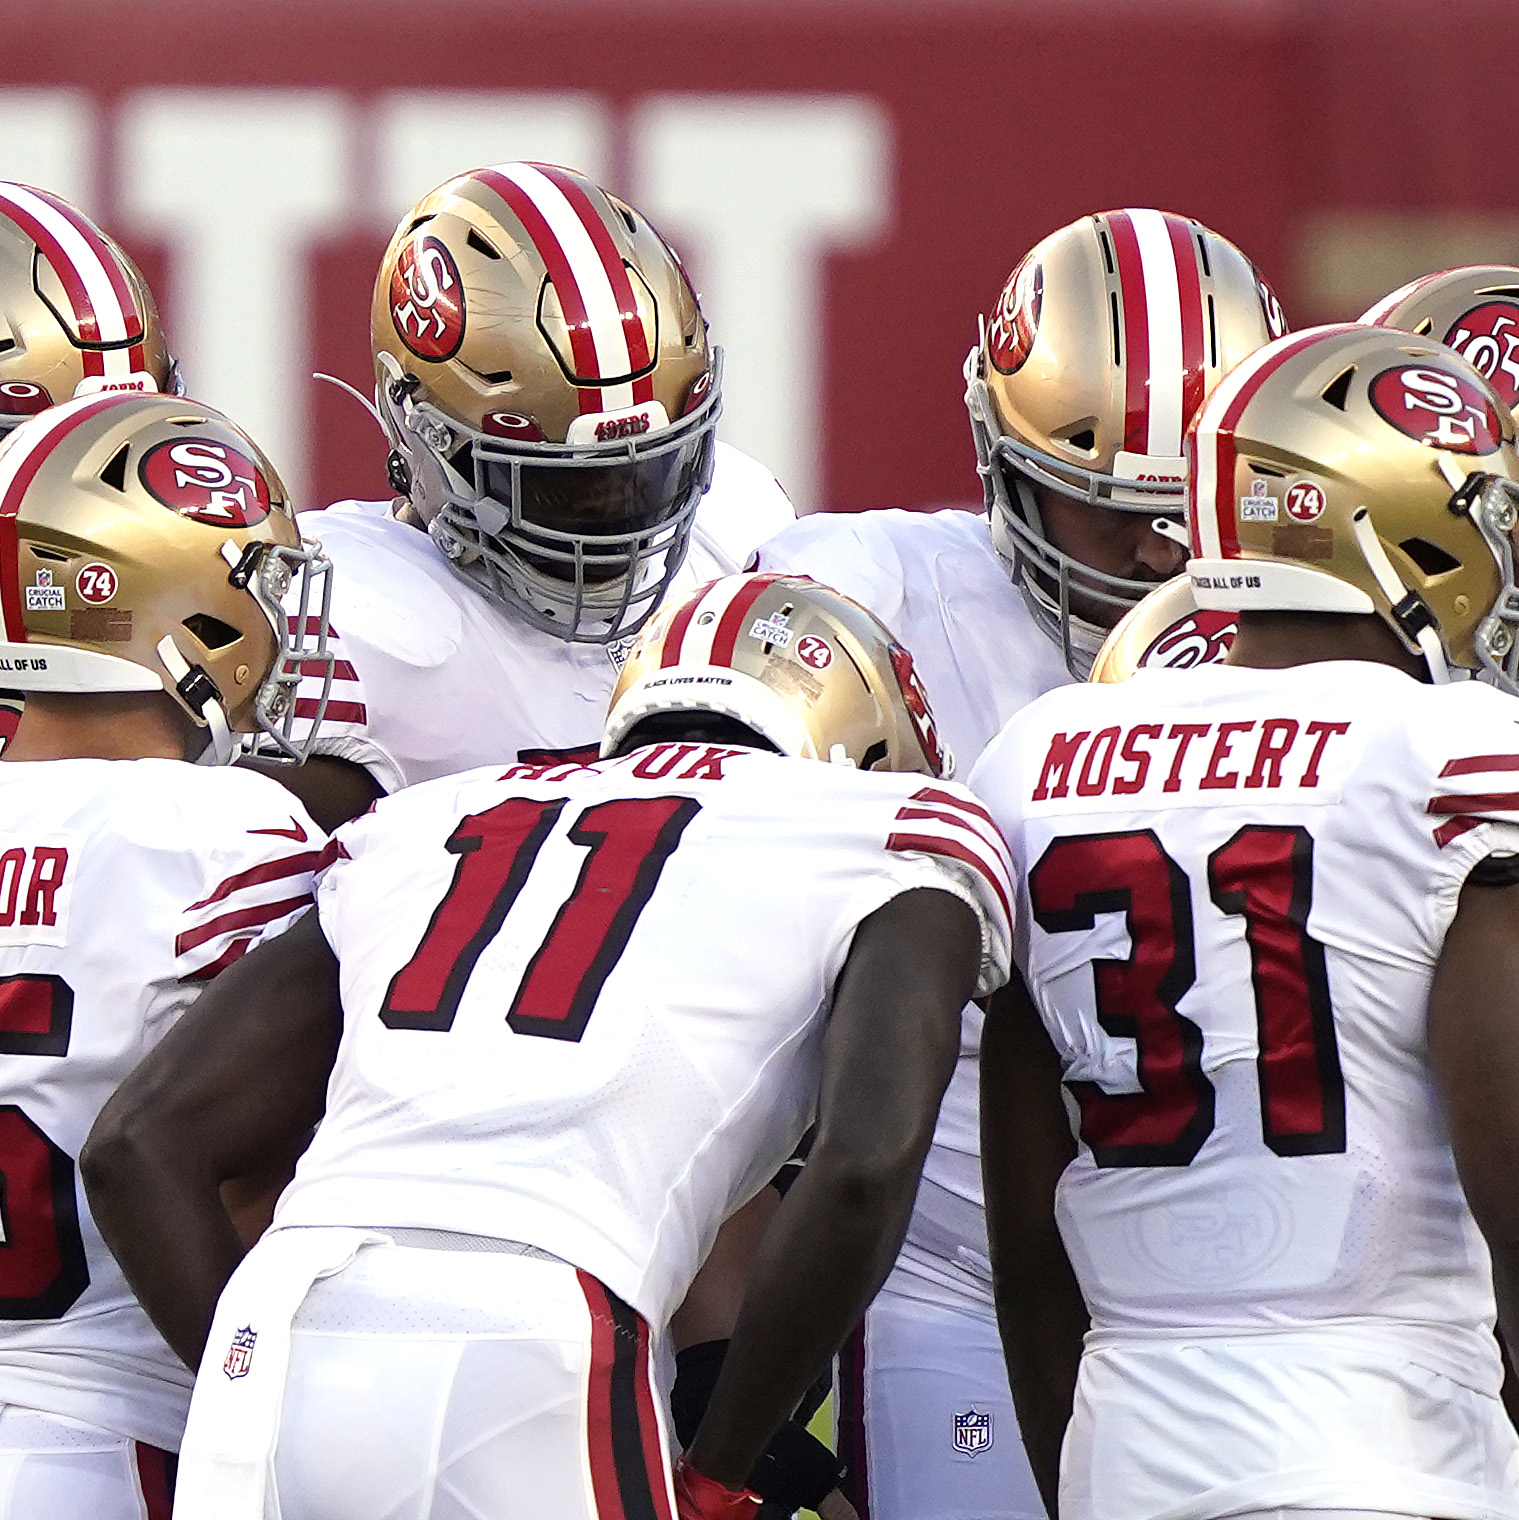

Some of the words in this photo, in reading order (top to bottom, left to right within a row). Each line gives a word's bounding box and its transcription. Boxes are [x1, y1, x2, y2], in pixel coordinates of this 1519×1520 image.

[1291, 488, 1320, 515] 74
[28, 588, 62, 596] CRUCIAL
[82, 570, 112, 597] 74
[1230, 576, 1244, 589] OF
[1245, 575, 1261, 589] US
[28, 596, 63, 607] CATCH
[753, 626, 788, 645] CATCH
[799, 637, 831, 668] 74
[14, 659, 29, 671] OF
[30, 658, 48, 671] US
[669, 676, 695, 685] LIVES
[696, 676, 733, 686] MATTER
[1031, 718, 1352, 802] MOSTERT
[377, 796, 704, 1044] 11
[1027, 823, 1348, 1168] 31
[224, 1347, 249, 1374] NFL
[958, 1428, 987, 1447] NFL
